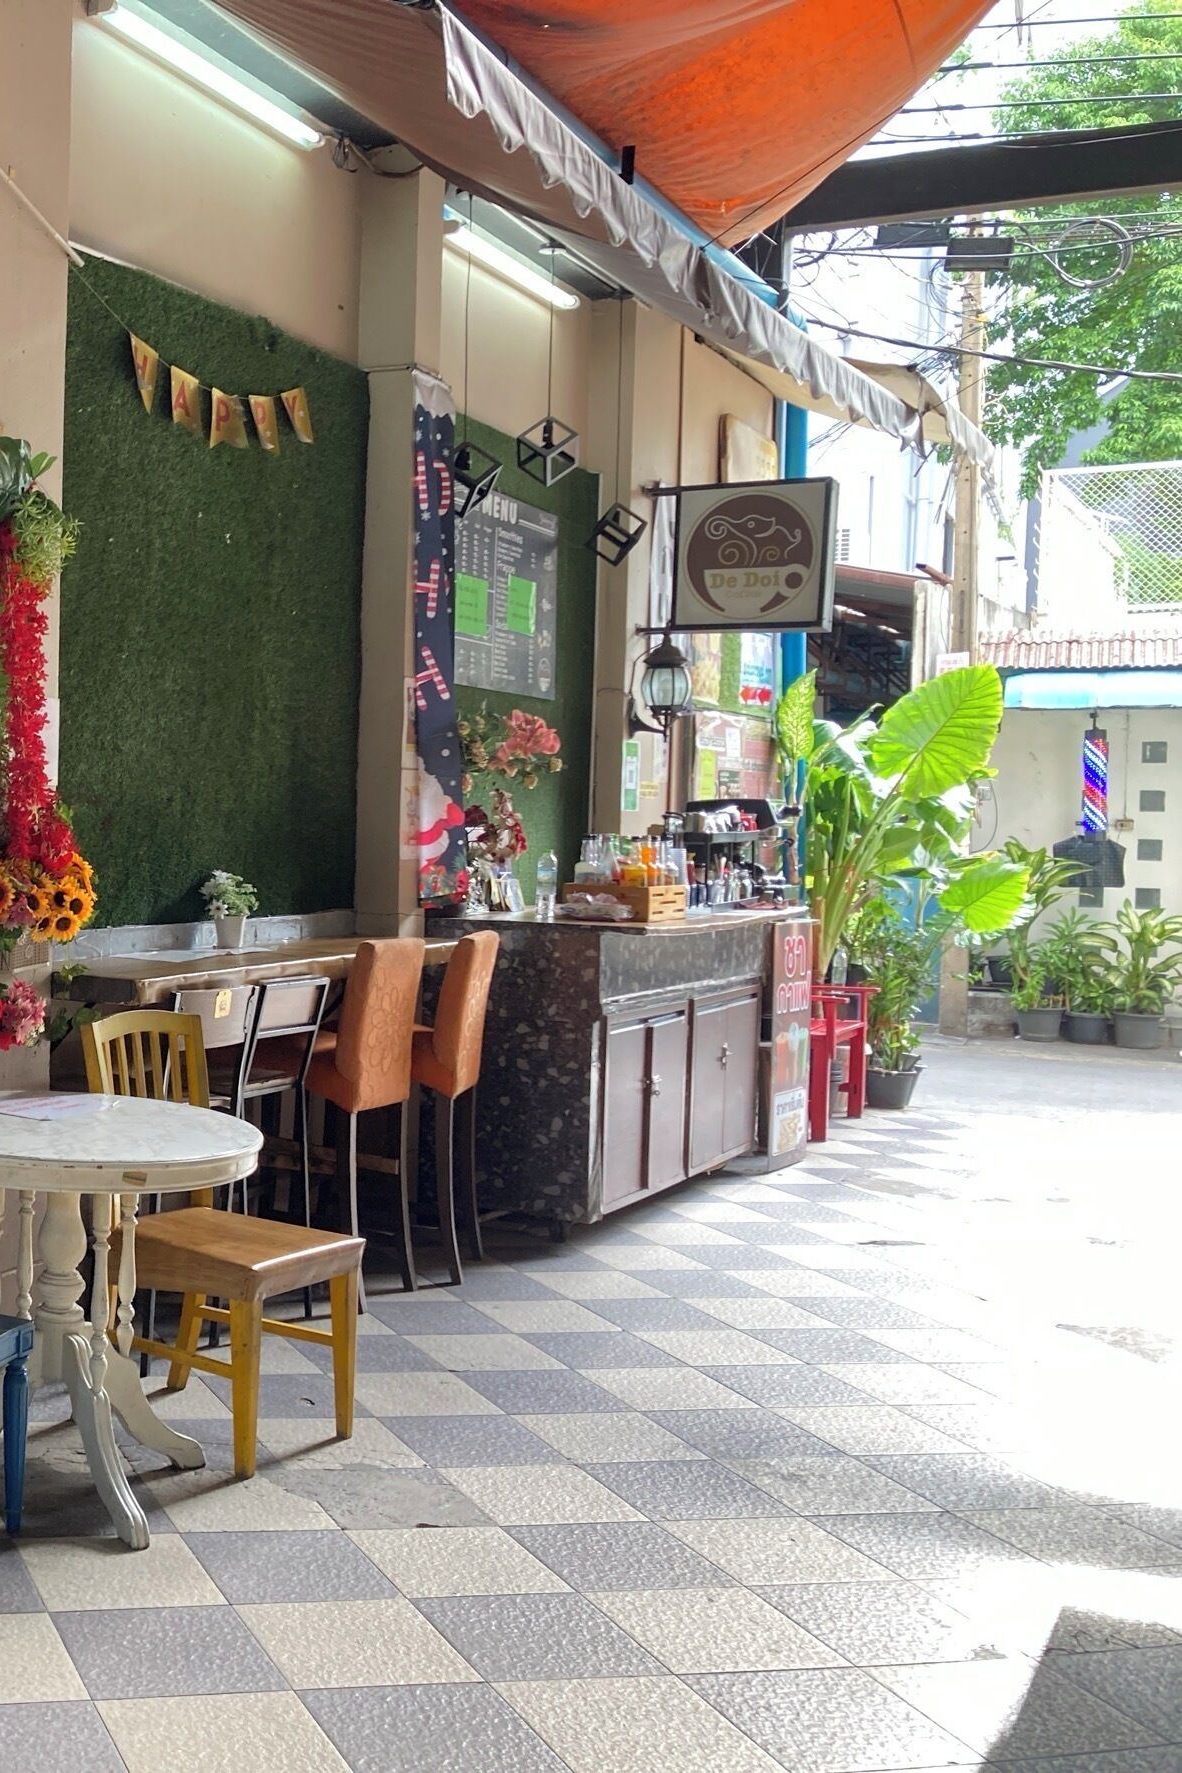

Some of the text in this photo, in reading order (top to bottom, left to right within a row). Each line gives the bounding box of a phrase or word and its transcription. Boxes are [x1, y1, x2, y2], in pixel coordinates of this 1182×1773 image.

[482, 494, 518, 525] MENU
[710, 571, 782, 589] De Doi
[784, 935, 807, 978] ชา
[777, 970, 812, 1014] กาแฟ
